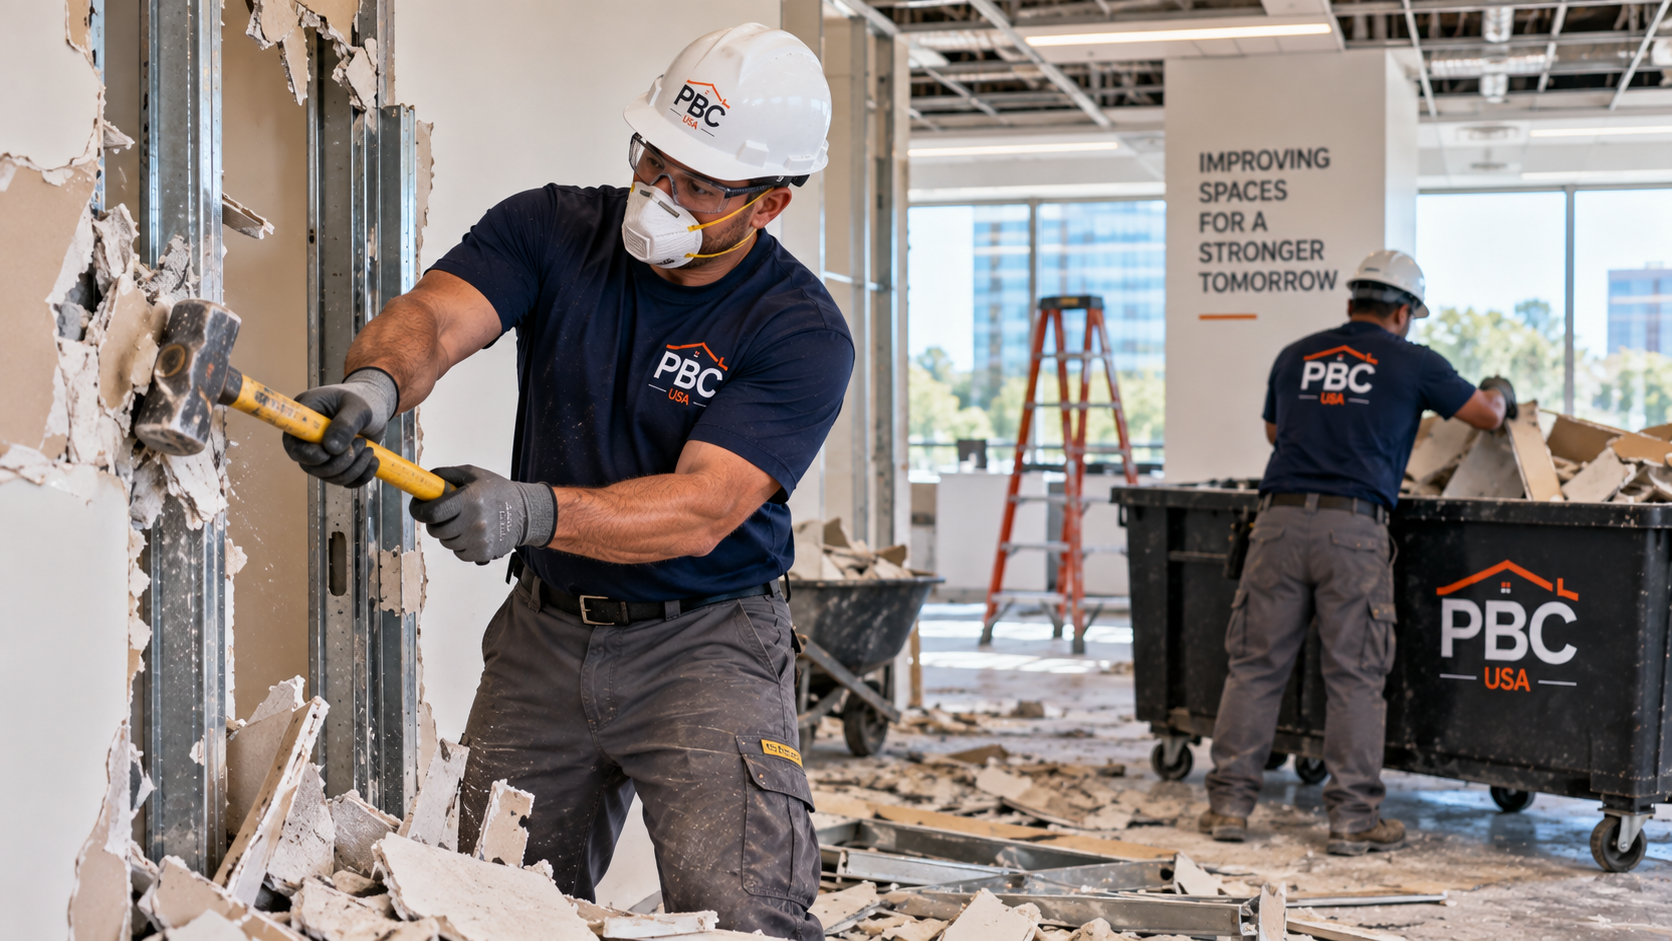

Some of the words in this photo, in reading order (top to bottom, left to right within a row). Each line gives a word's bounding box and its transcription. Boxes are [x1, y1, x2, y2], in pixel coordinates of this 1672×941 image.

[673, 84, 726, 127] PBC
[682, 115, 698, 130] USA
[1199, 147, 1330, 173] IMPROVING
[1199, 179, 1288, 203] SPACES
[1199, 211, 1245, 233] FOR
[1251, 210, 1268, 232] A
[1199, 239, 1324, 263] STRONGER
[1199, 270, 1338, 293] TOMORROW
[653, 350, 723, 398] PBC
[1300, 361, 1376, 394] PBC
[668, 388, 690, 406] USA
[1320, 392, 1345, 406] USA
[1441, 598, 1578, 665] PBC
[1484, 666, 1531, 692] USA
